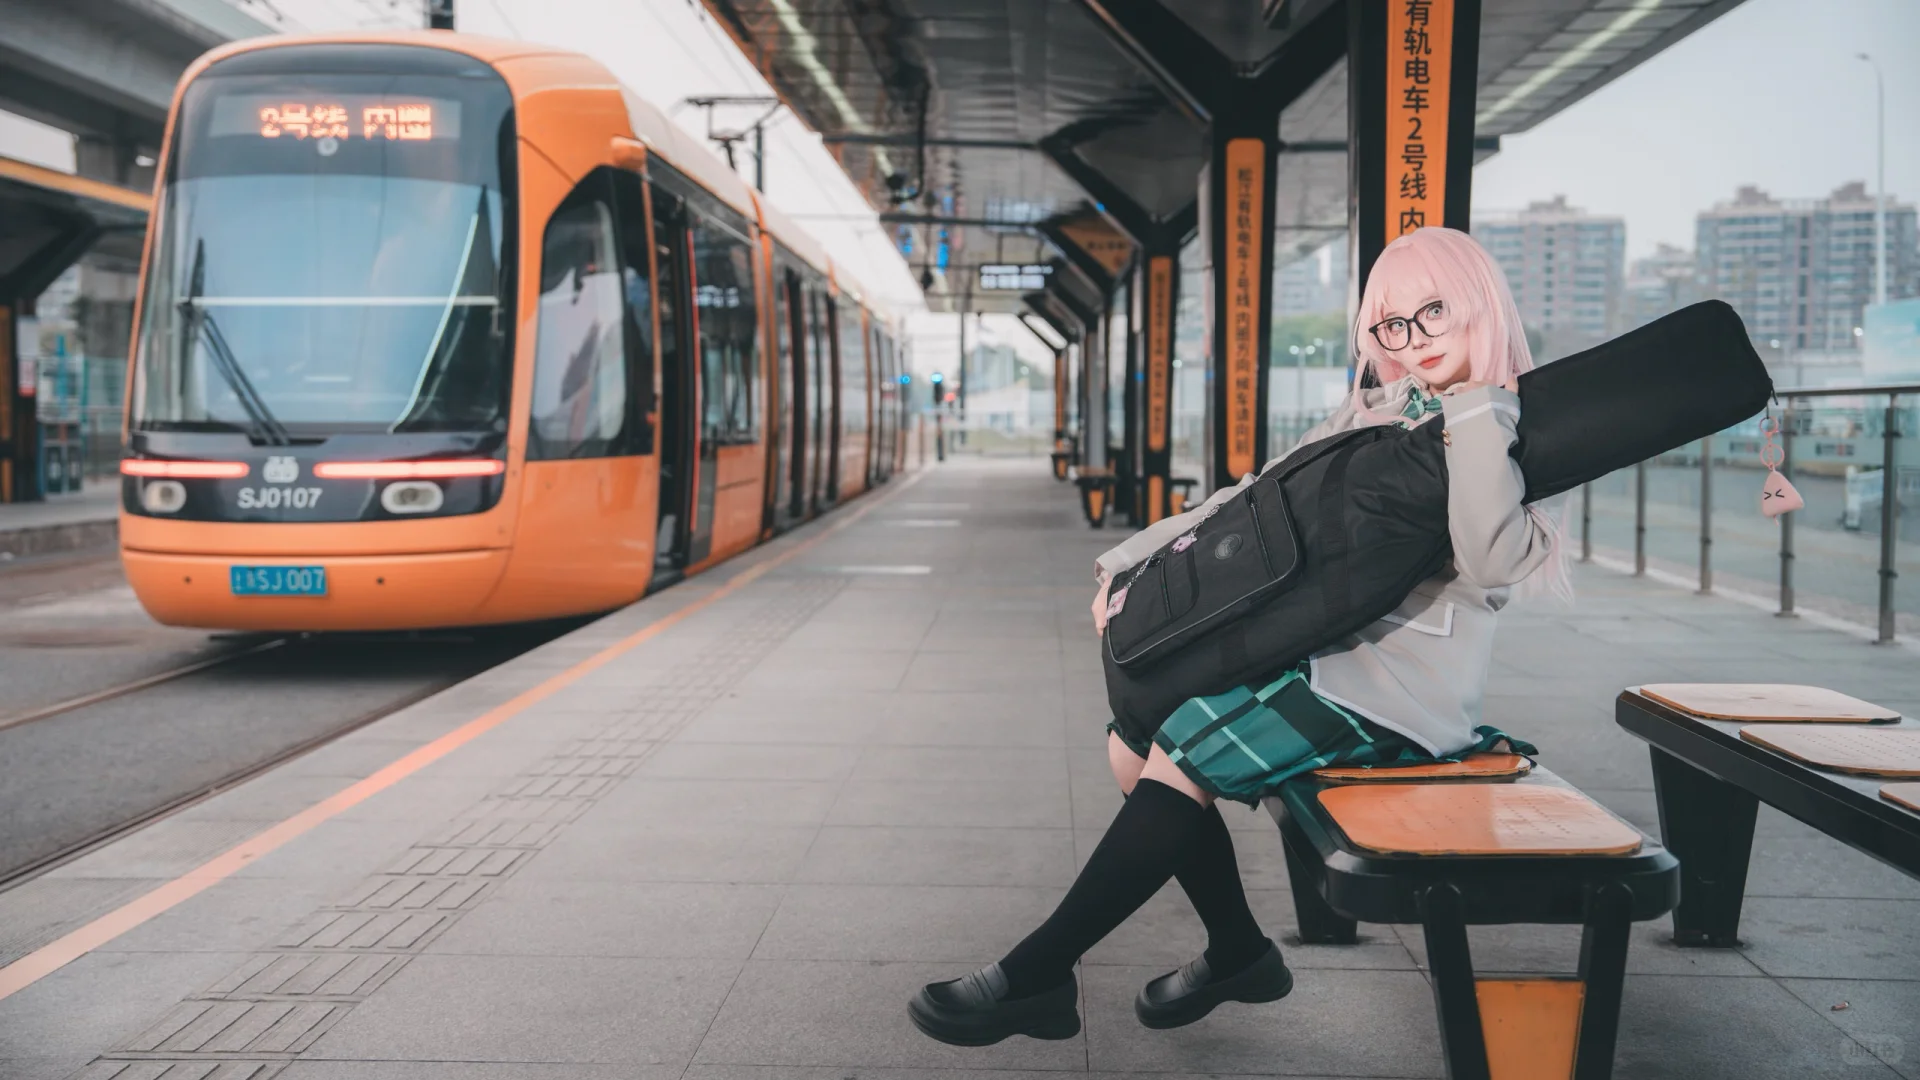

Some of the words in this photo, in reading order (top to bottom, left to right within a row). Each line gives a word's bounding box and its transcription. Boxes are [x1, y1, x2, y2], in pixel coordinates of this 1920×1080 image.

[1400, 0, 1432, 200] 有轨电车2号线
[237, 487, 323, 509] SJ0107
